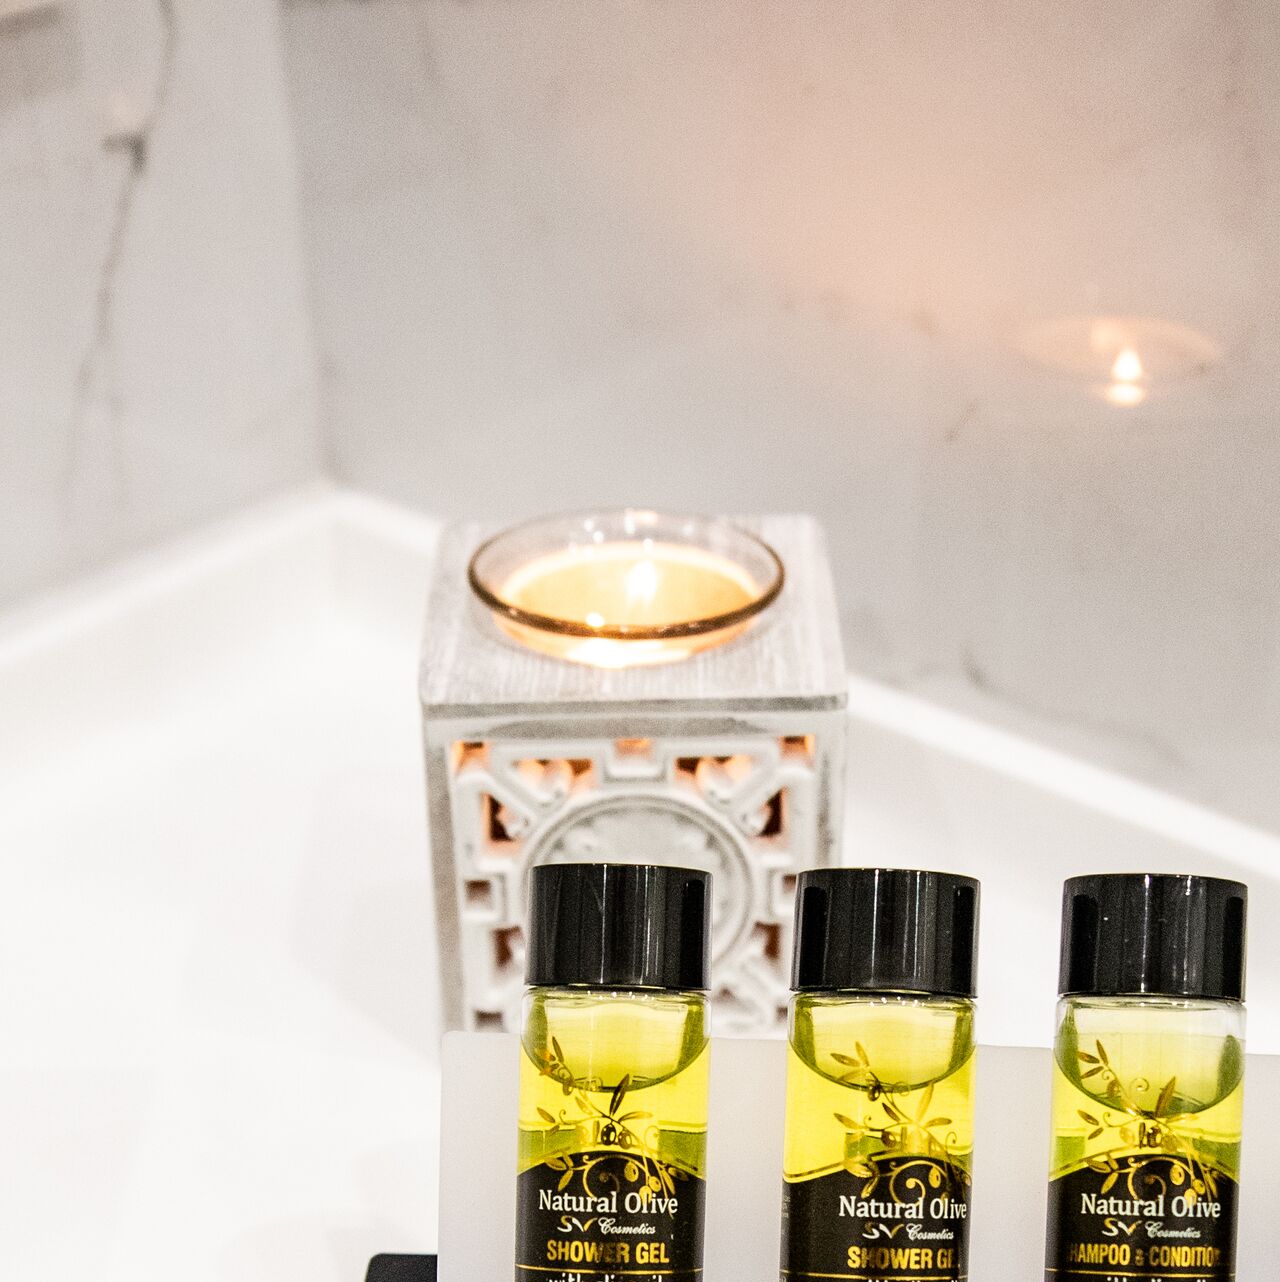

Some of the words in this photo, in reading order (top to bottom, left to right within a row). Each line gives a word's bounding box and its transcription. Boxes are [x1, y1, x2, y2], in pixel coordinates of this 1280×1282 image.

[539, 1189, 618, 1214] Natural
[624, 1191, 679, 1215] Olive
[839, 1195, 923, 1219] Natural
[929, 1198, 967, 1220] Olive
[1081, 1193, 1164, 1217] Natural
[1171, 1196, 1221, 1219] Olive
[598, 1217, 656, 1235] Cosmetics
[905, 1223, 954, 1241] Cosmetics
[1144, 1220, 1201, 1239] Cosmetics
[546, 1239, 630, 1264] SHOWER
[636, 1241, 670, 1264] GEL
[847, 1246, 933, 1269] SHOWER
